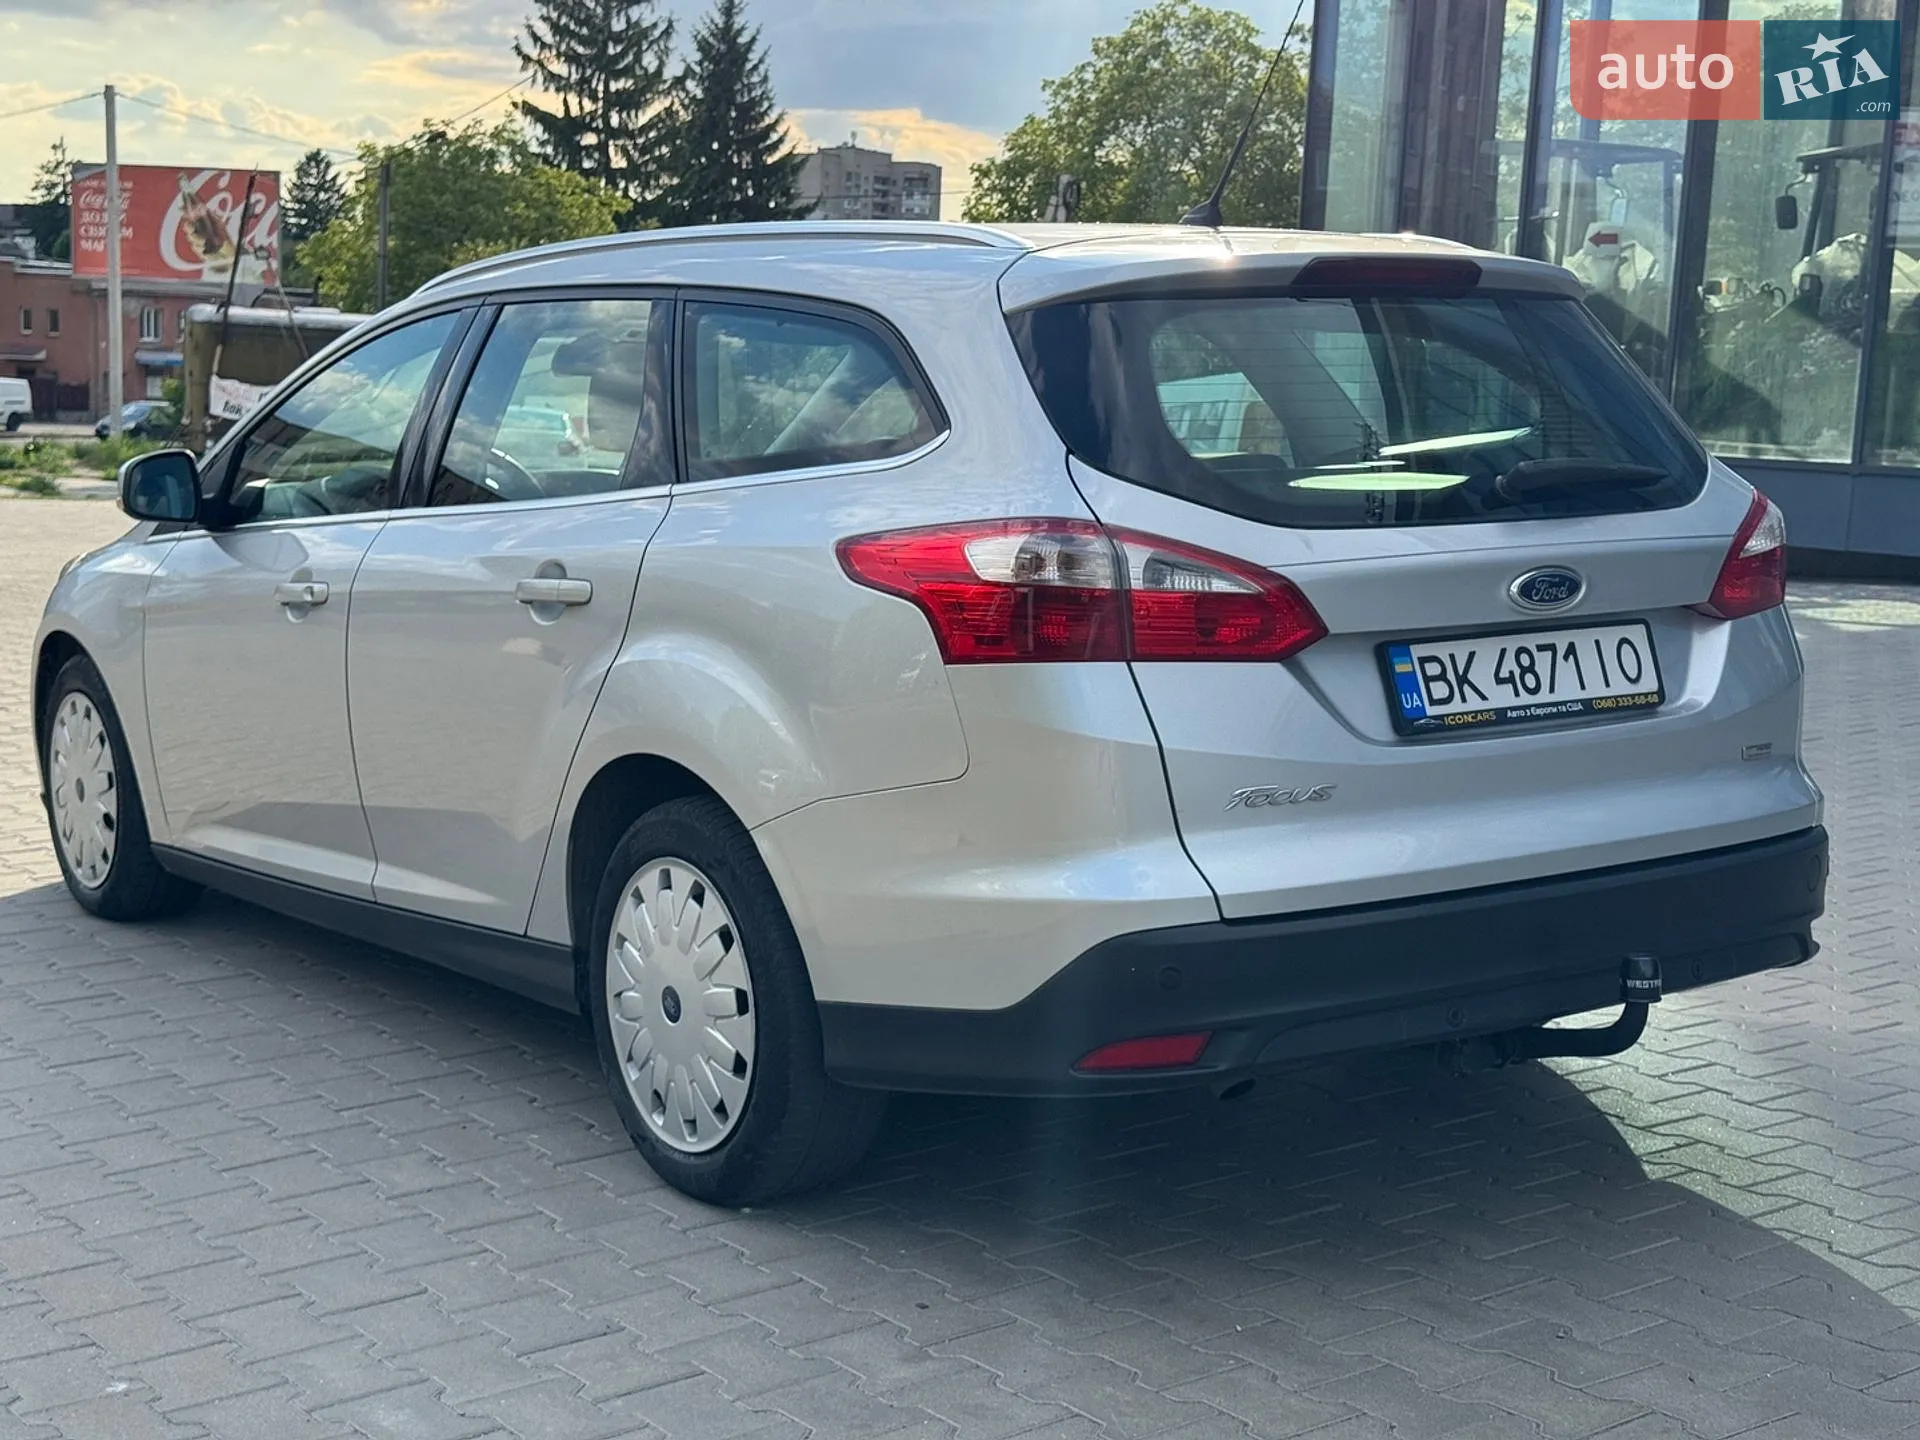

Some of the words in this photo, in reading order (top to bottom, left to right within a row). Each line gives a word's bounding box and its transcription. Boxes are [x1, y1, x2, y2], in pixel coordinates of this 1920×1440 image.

[1531, 577, 1570, 601] Ford
[1417, 650, 1489, 707] BK
[1493, 641, 1586, 698] 4871
[1594, 636, 1642, 688] IO
[1401, 691, 1423, 709] UA
[1444, 711, 1497, 726] ICONCARS
